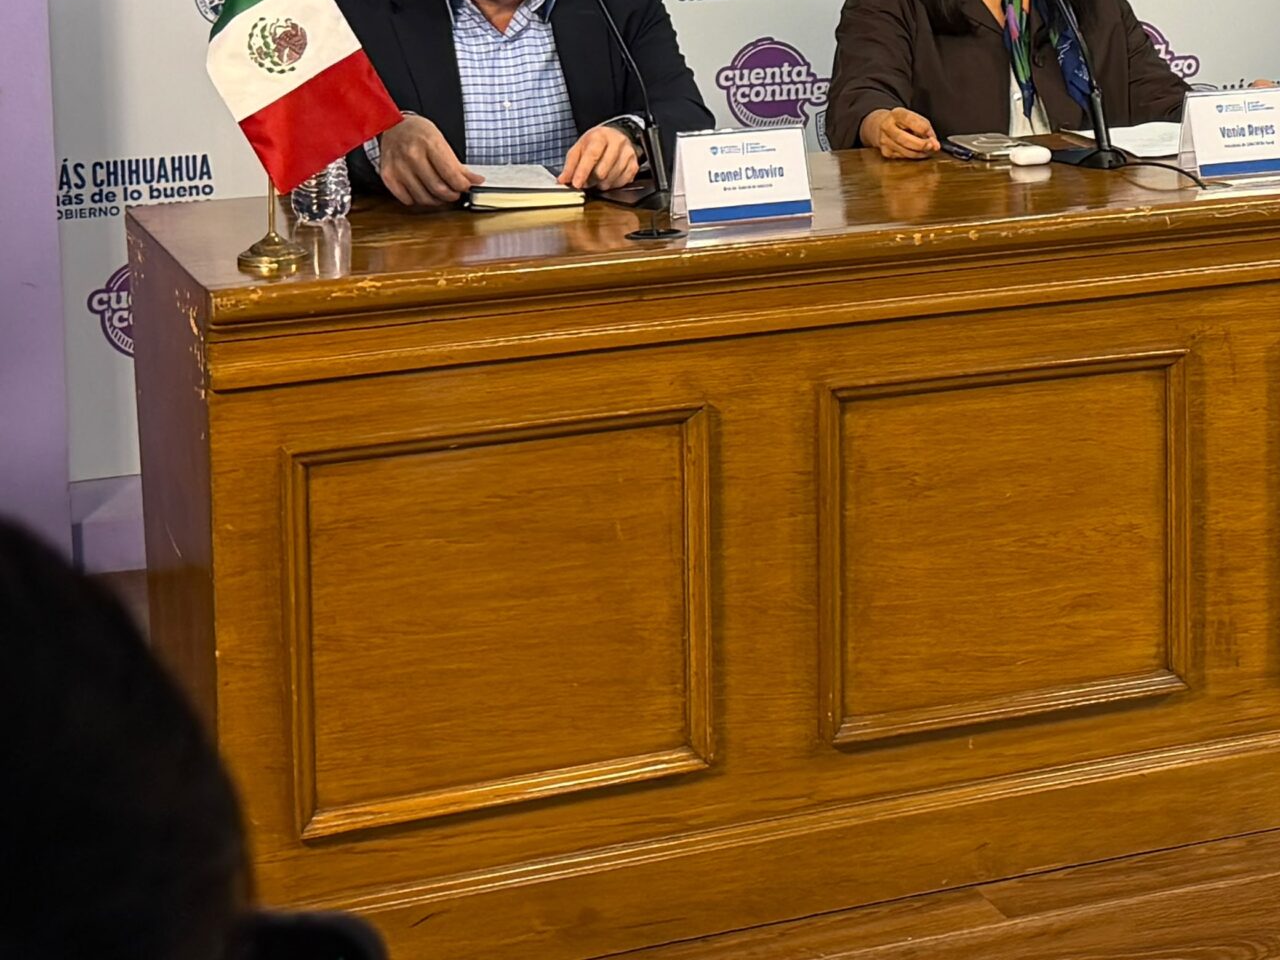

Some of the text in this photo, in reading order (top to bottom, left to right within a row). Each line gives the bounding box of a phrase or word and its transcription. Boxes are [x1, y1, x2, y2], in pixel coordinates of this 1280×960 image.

[719, 62, 807, 86] cuenta
[736, 78, 830, 103] conmig
[92, 154, 212, 187] CHIHUAHUA
[708, 167, 742, 183] Leonel
[91, 184, 214, 203] de lo bueno
